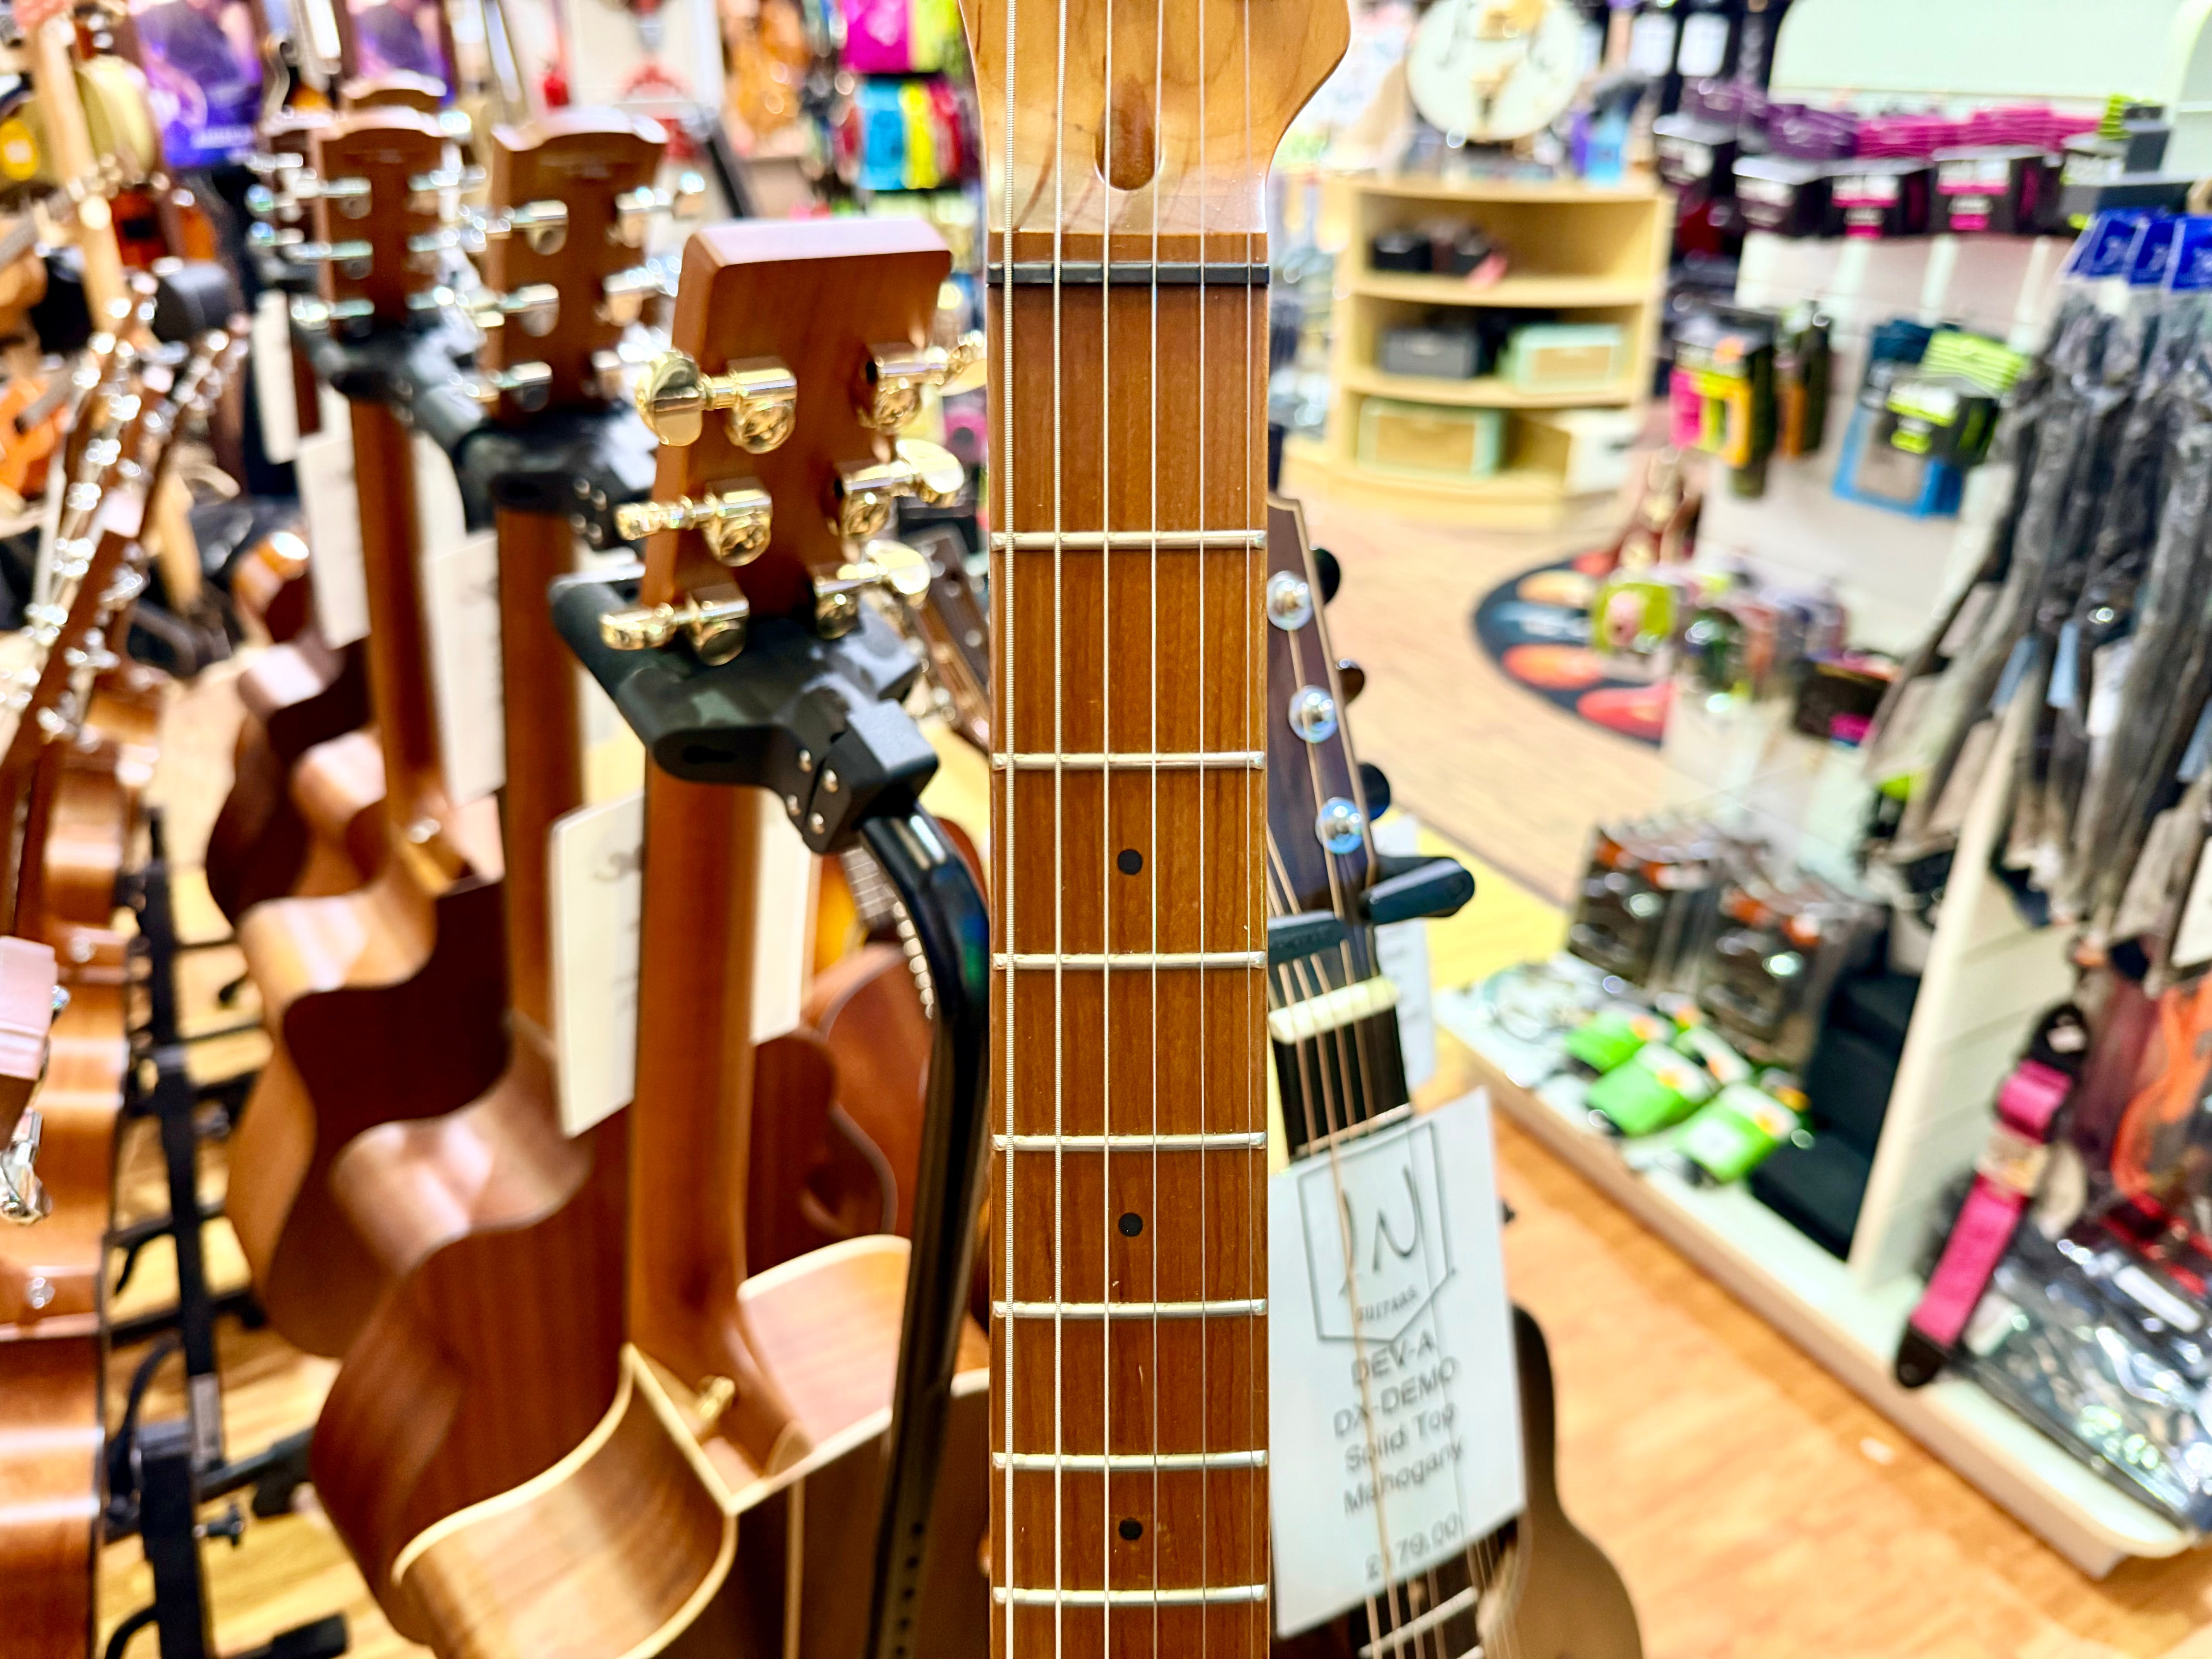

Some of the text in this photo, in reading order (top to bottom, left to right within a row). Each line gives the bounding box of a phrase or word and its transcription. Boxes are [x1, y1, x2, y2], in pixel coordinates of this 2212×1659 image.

[1352, 1330, 1434, 1386] DEV-A
[1345, 1402, 1455, 1472] Solid Top
[1343, 1435, 1462, 1515] Mahogany
